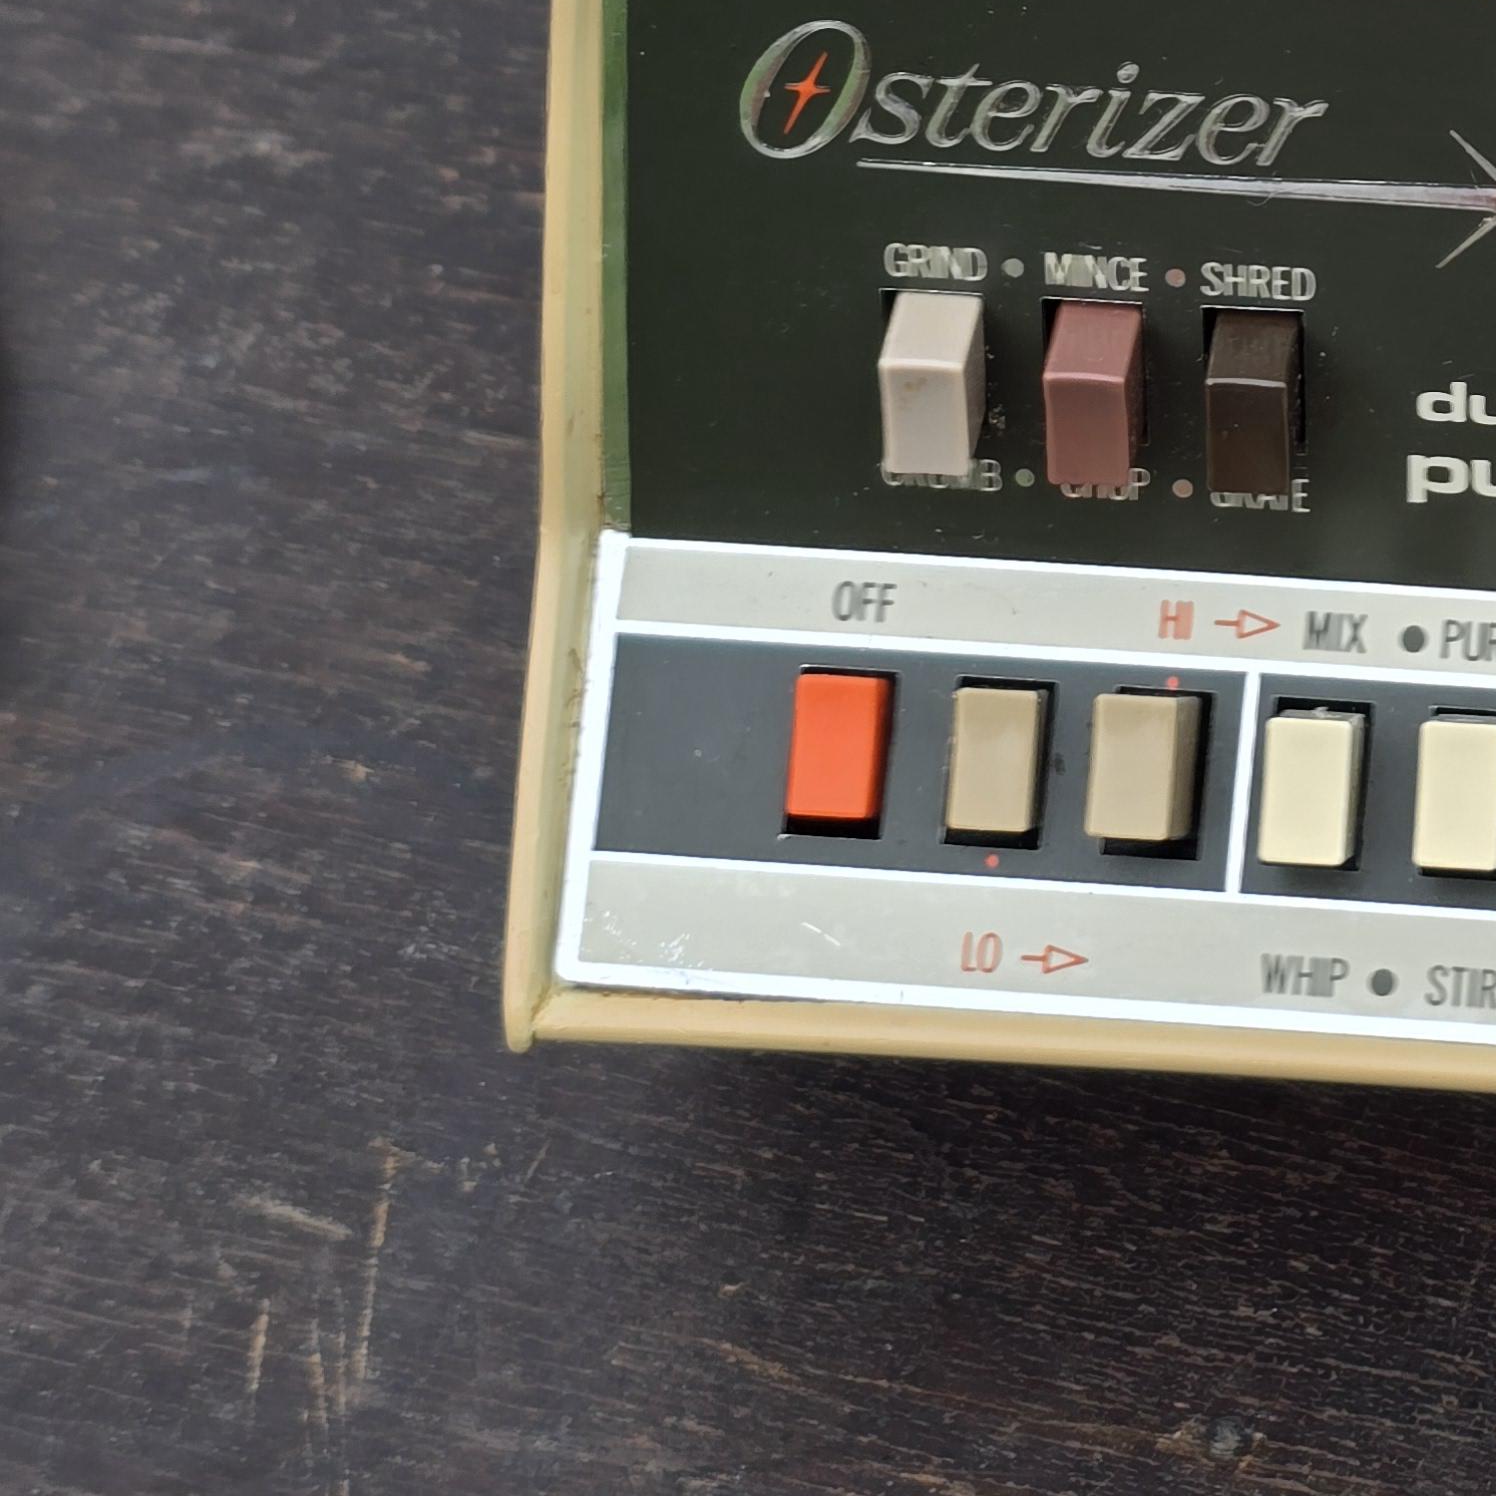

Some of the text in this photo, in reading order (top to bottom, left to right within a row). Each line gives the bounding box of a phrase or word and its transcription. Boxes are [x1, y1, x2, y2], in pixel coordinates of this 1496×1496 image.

[738, 18, 1330, 168] Osterizer
[883, 242, 1317, 302] GRIND MINCE SHRED
[832, 581, 897, 623] OFF
[1158, 599, 1194, 640] HI
[1303, 611, 1369, 654] MIX
[960, 931, 1001, 974] LO
[1261, 953, 1349, 998] WHIP
